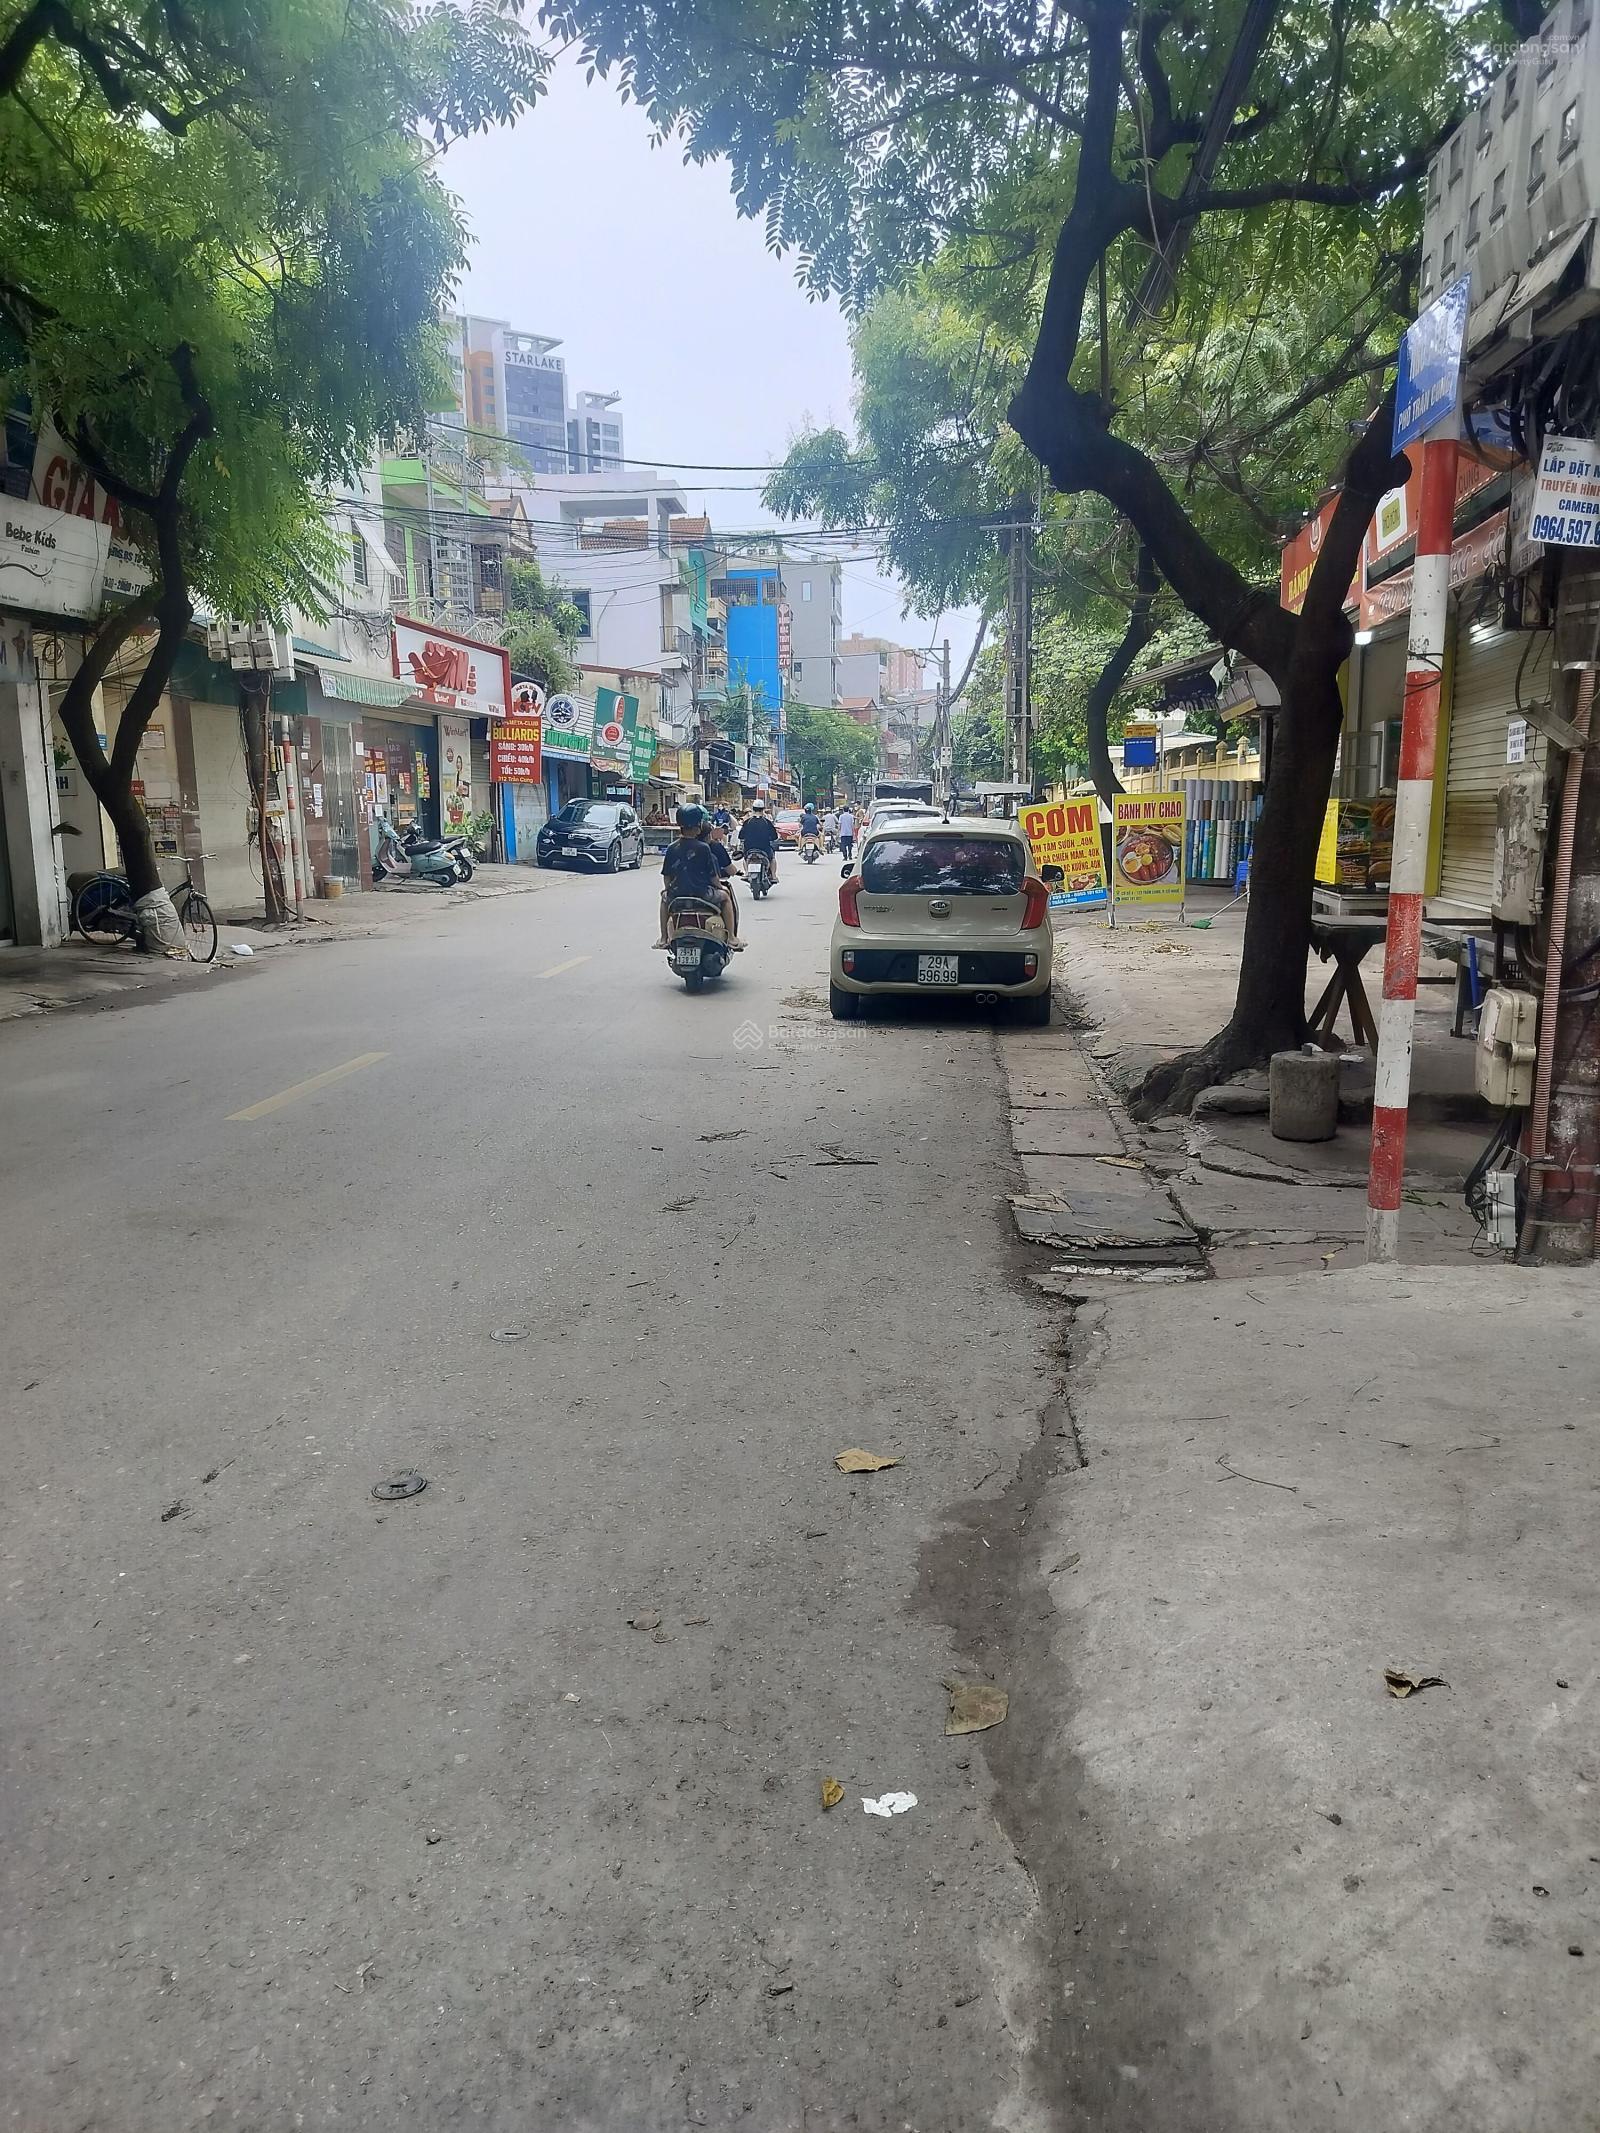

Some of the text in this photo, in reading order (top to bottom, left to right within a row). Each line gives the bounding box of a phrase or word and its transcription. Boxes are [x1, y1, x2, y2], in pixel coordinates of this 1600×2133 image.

[505, 351, 562, 371] STARLAKE
[1558, 499, 1600, 515] CAMERA
[5, 522, 57, 549] Bebe Kids
[21, 544, 41, 556] Fashion
[492, 727, 540, 742] BILLIARDS
[1025, 803, 1094, 840] CƠM
[927, 956, 950, 969] 29A
[919, 969, 957, 983] 596.99
